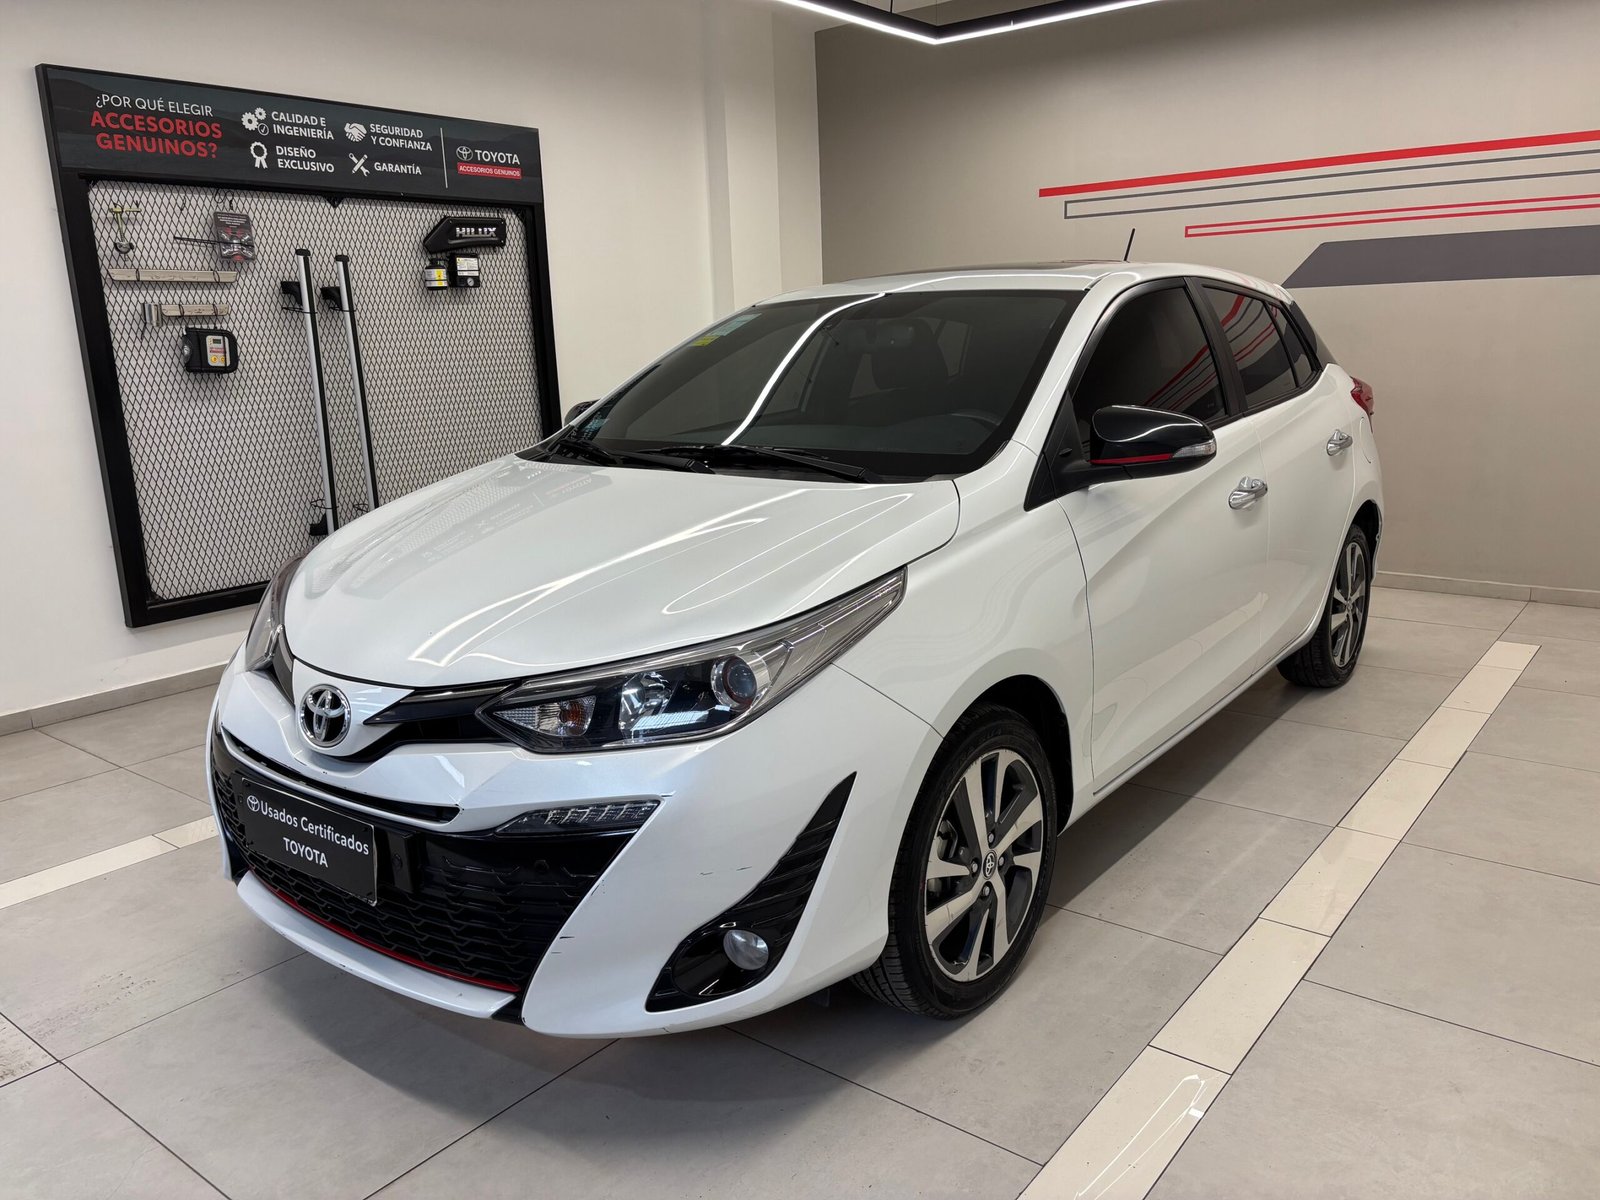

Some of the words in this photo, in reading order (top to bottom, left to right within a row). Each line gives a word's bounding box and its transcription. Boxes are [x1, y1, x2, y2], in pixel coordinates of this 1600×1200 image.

[96, 94, 132, 108] ¿POR
[135, 97, 165, 112] QUÉ
[168, 101, 213, 117] ELEGIR
[90, 111, 222, 139] ACCESORIOS
[271, 111, 318, 126] CALIDAD
[320, 117, 326, 127] E
[273, 124, 334, 140] INGENIERÍA
[369, 123, 423, 138] SEGURIDAD
[96, 132, 218, 158] GENUINOS?
[370, 135, 377, 145] Y
[378, 137, 432, 151] CONFIANZA
[275, 145, 316, 159] DISEÑO
[474, 149, 520, 165] TOYOTA
[277, 158, 335, 173] EXCLUSIVO
[374, 161, 422, 175] GARANTÍA
[459, 165, 493, 174] ACCESORIOS
[494, 168, 521, 176] GENUINOS
[455, 227, 497, 237] HILUX
[260, 800, 298, 828] Usados
[300, 817, 369, 855] Certificados
[283, 837, 329, 868] TOYOTA
